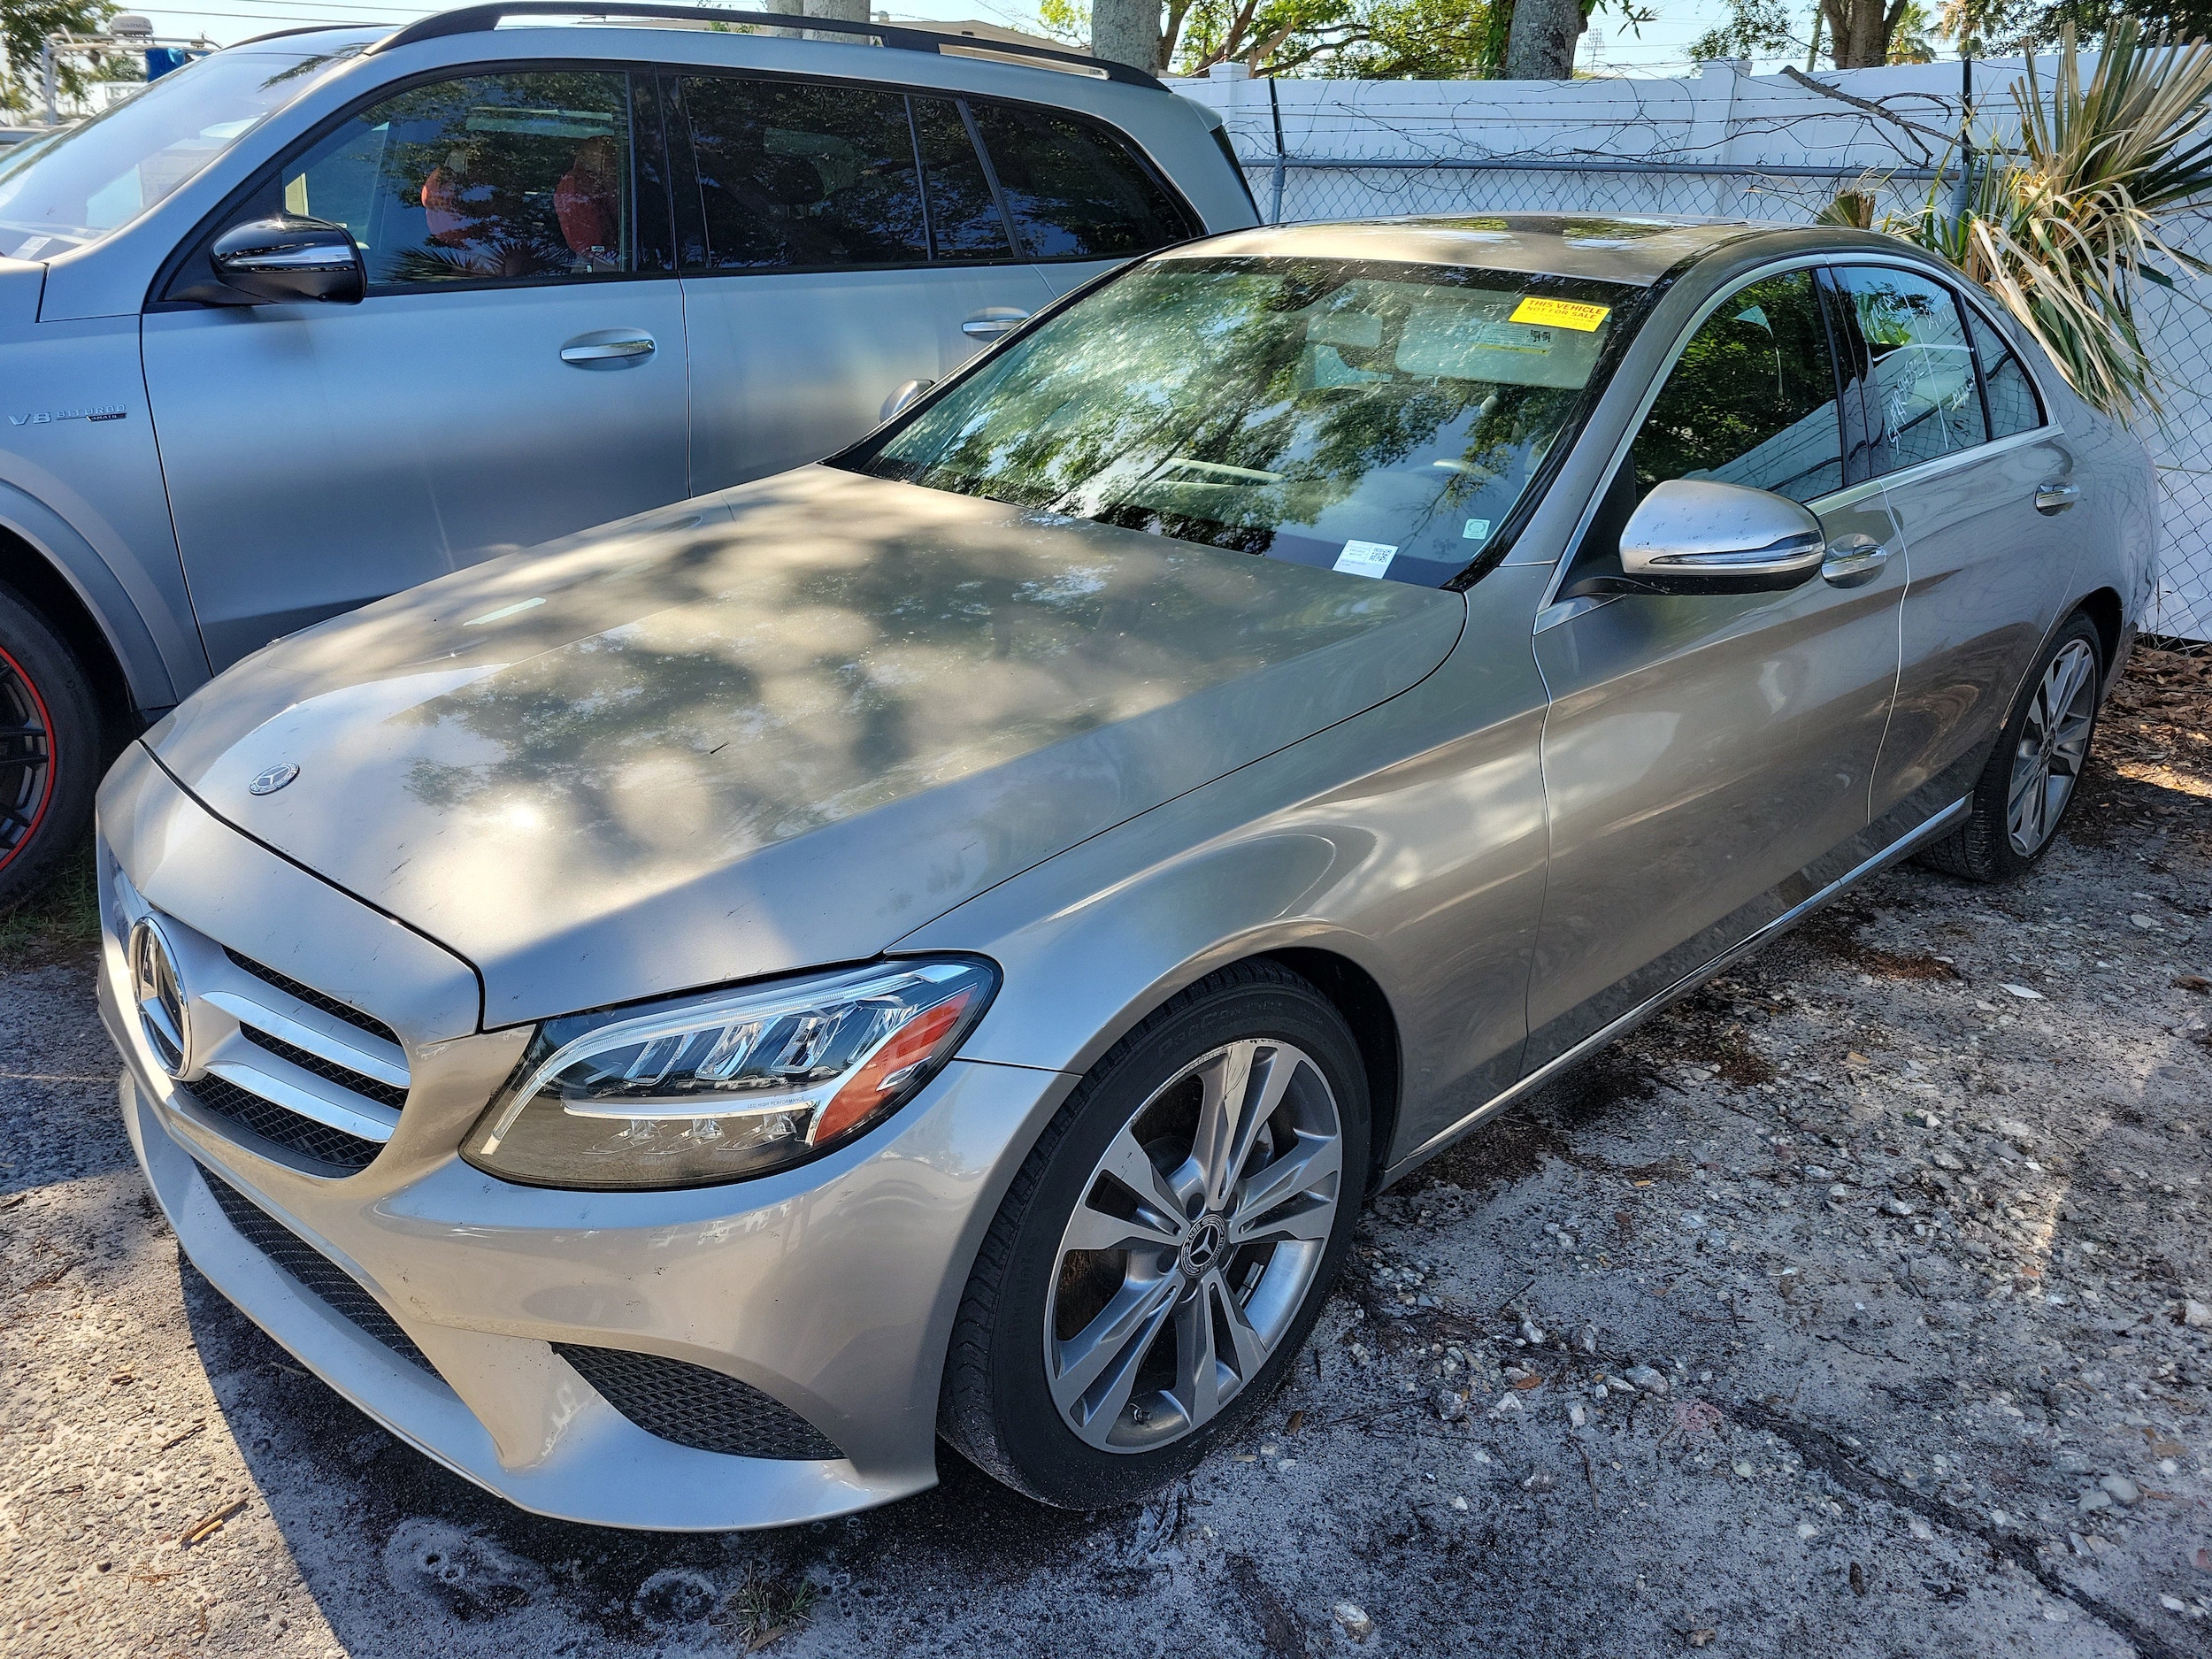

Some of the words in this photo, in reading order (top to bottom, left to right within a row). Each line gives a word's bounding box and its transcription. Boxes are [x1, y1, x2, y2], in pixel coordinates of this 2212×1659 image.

[1556, 303, 1605, 314] VEHICLE
[8, 411, 52, 426] V8
[57, 404, 126, 418] BITURBO
[770, 1096, 805, 1106] PERFORMANCE
[1186, 1223, 1202, 1244] BENZ
